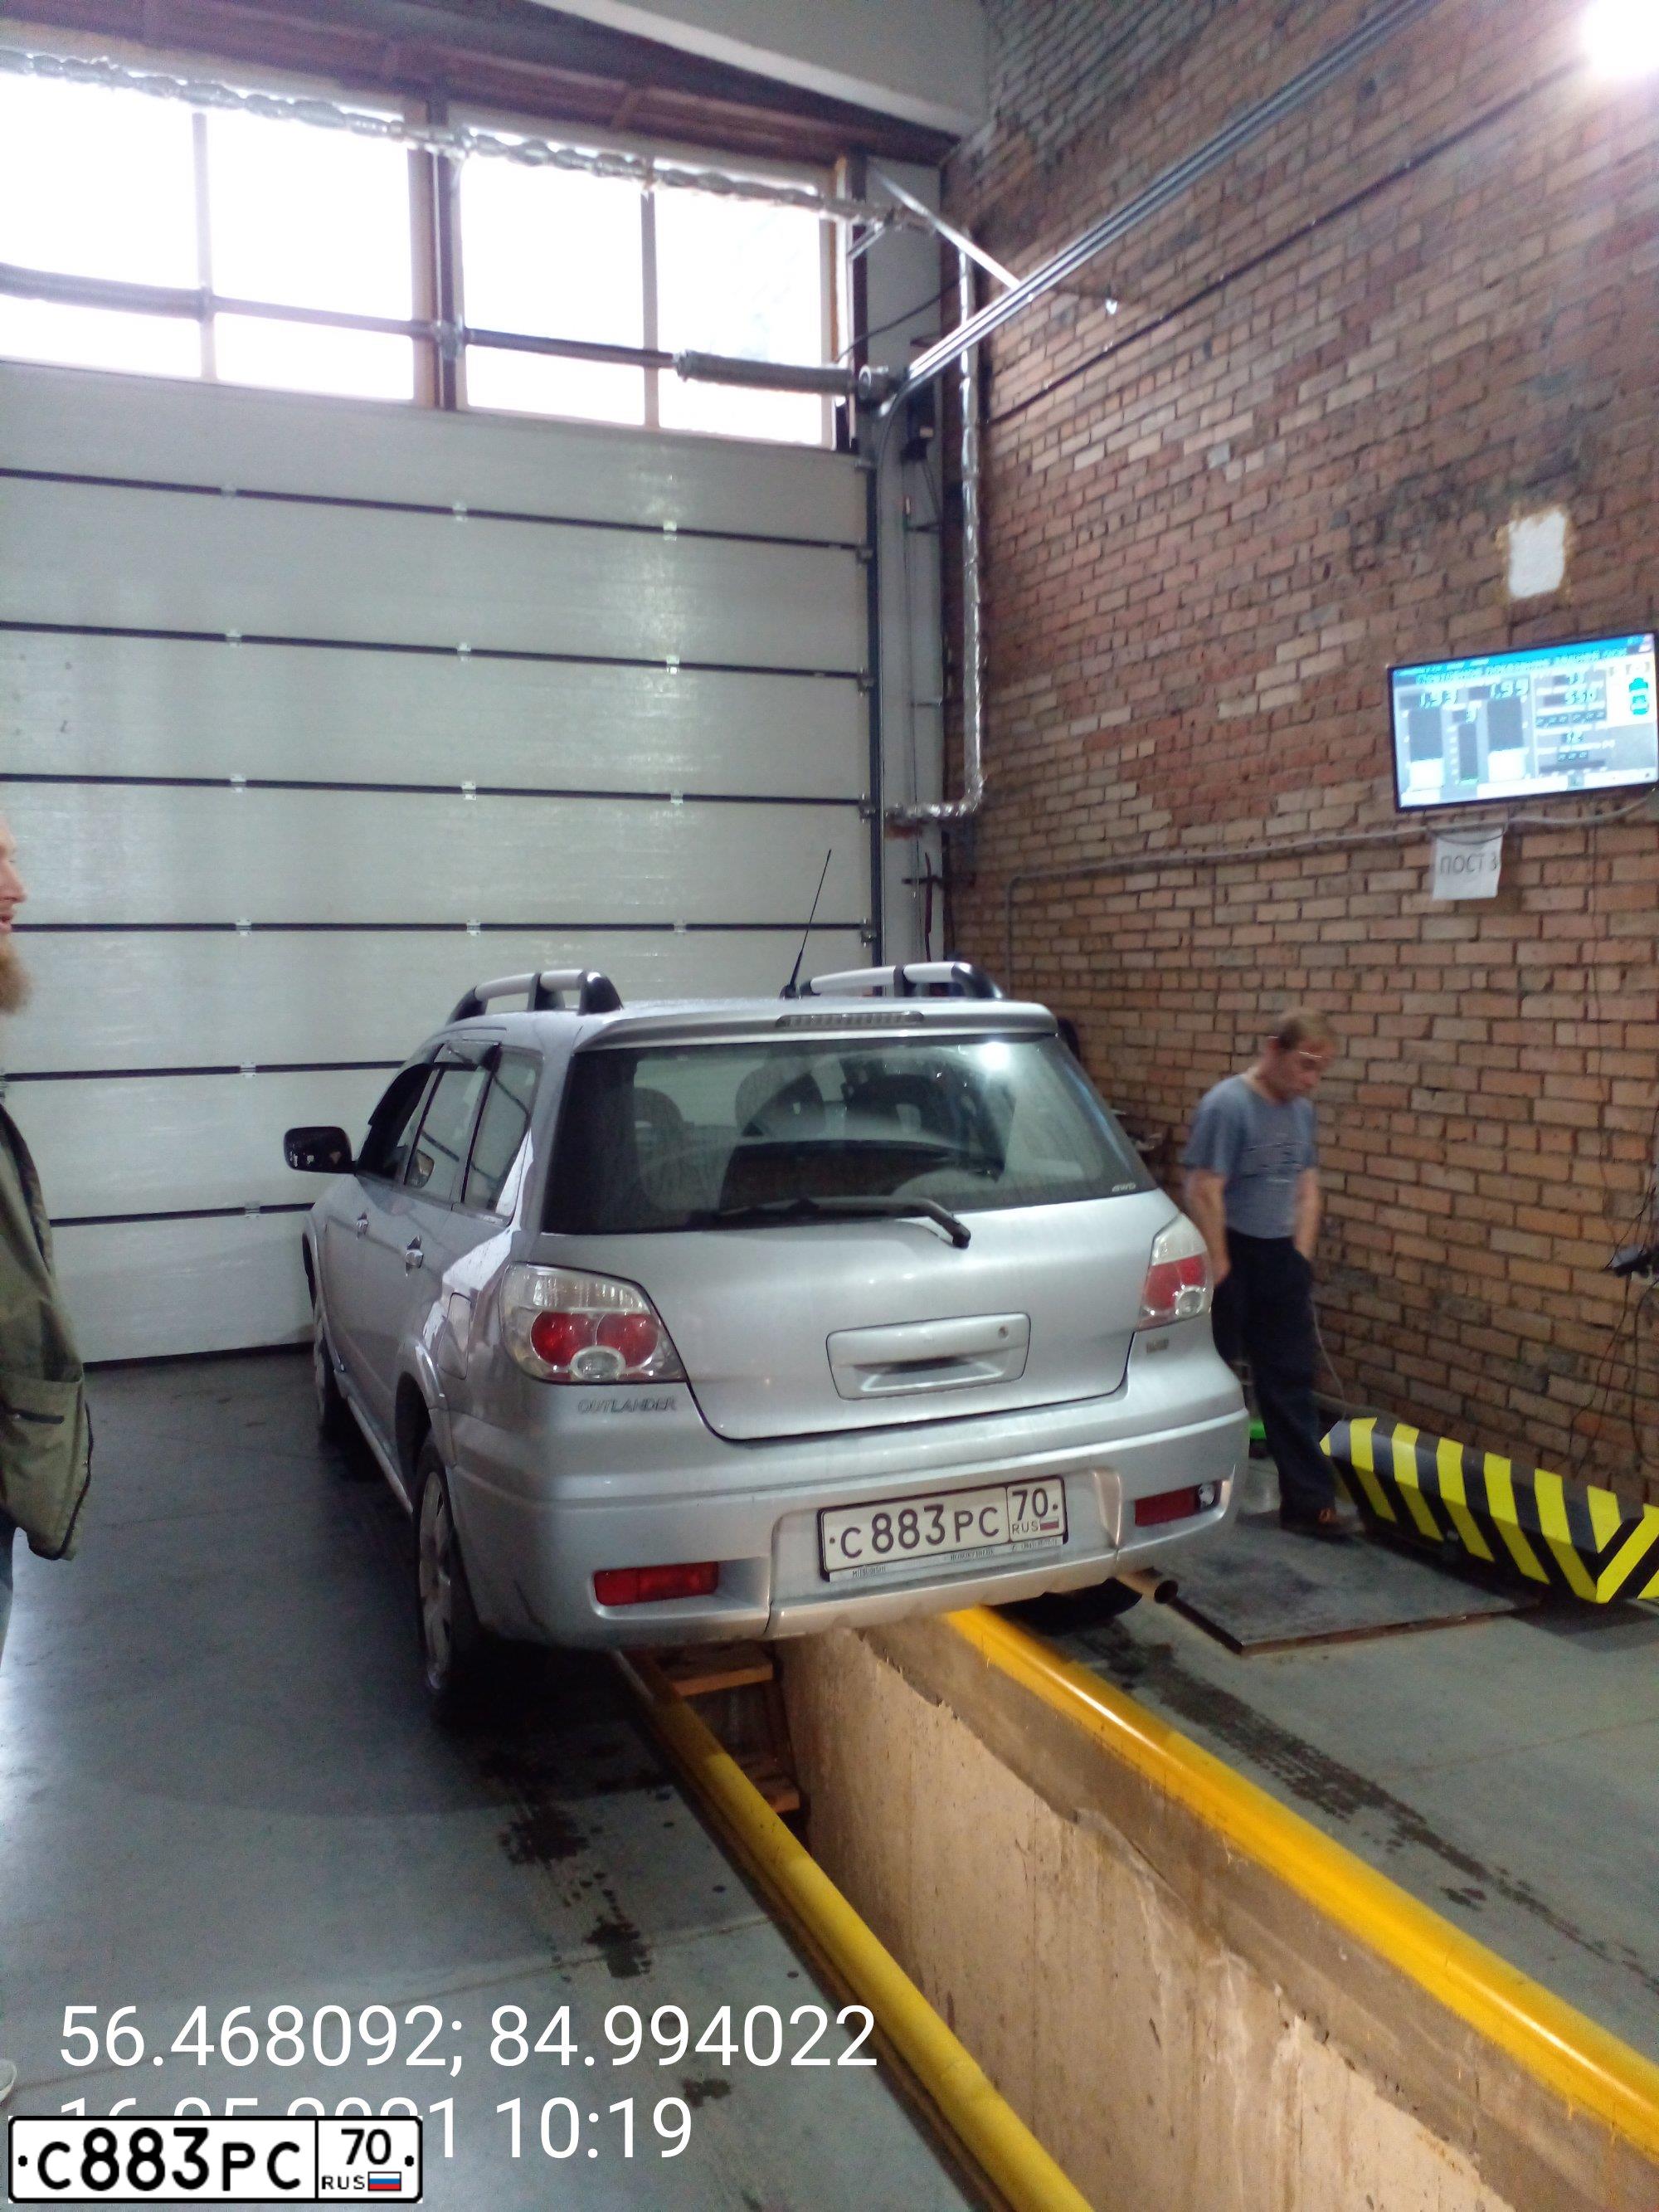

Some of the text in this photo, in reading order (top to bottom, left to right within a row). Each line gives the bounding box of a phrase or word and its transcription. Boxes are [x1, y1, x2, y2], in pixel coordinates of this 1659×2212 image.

[1440, 853, 1485, 875] ПОСТ
[578, 1396, 678, 1414] OUTLANDER
[1011, 1488, 1048, 1522] 70
[1011, 1522, 1039, 1535] RUS
